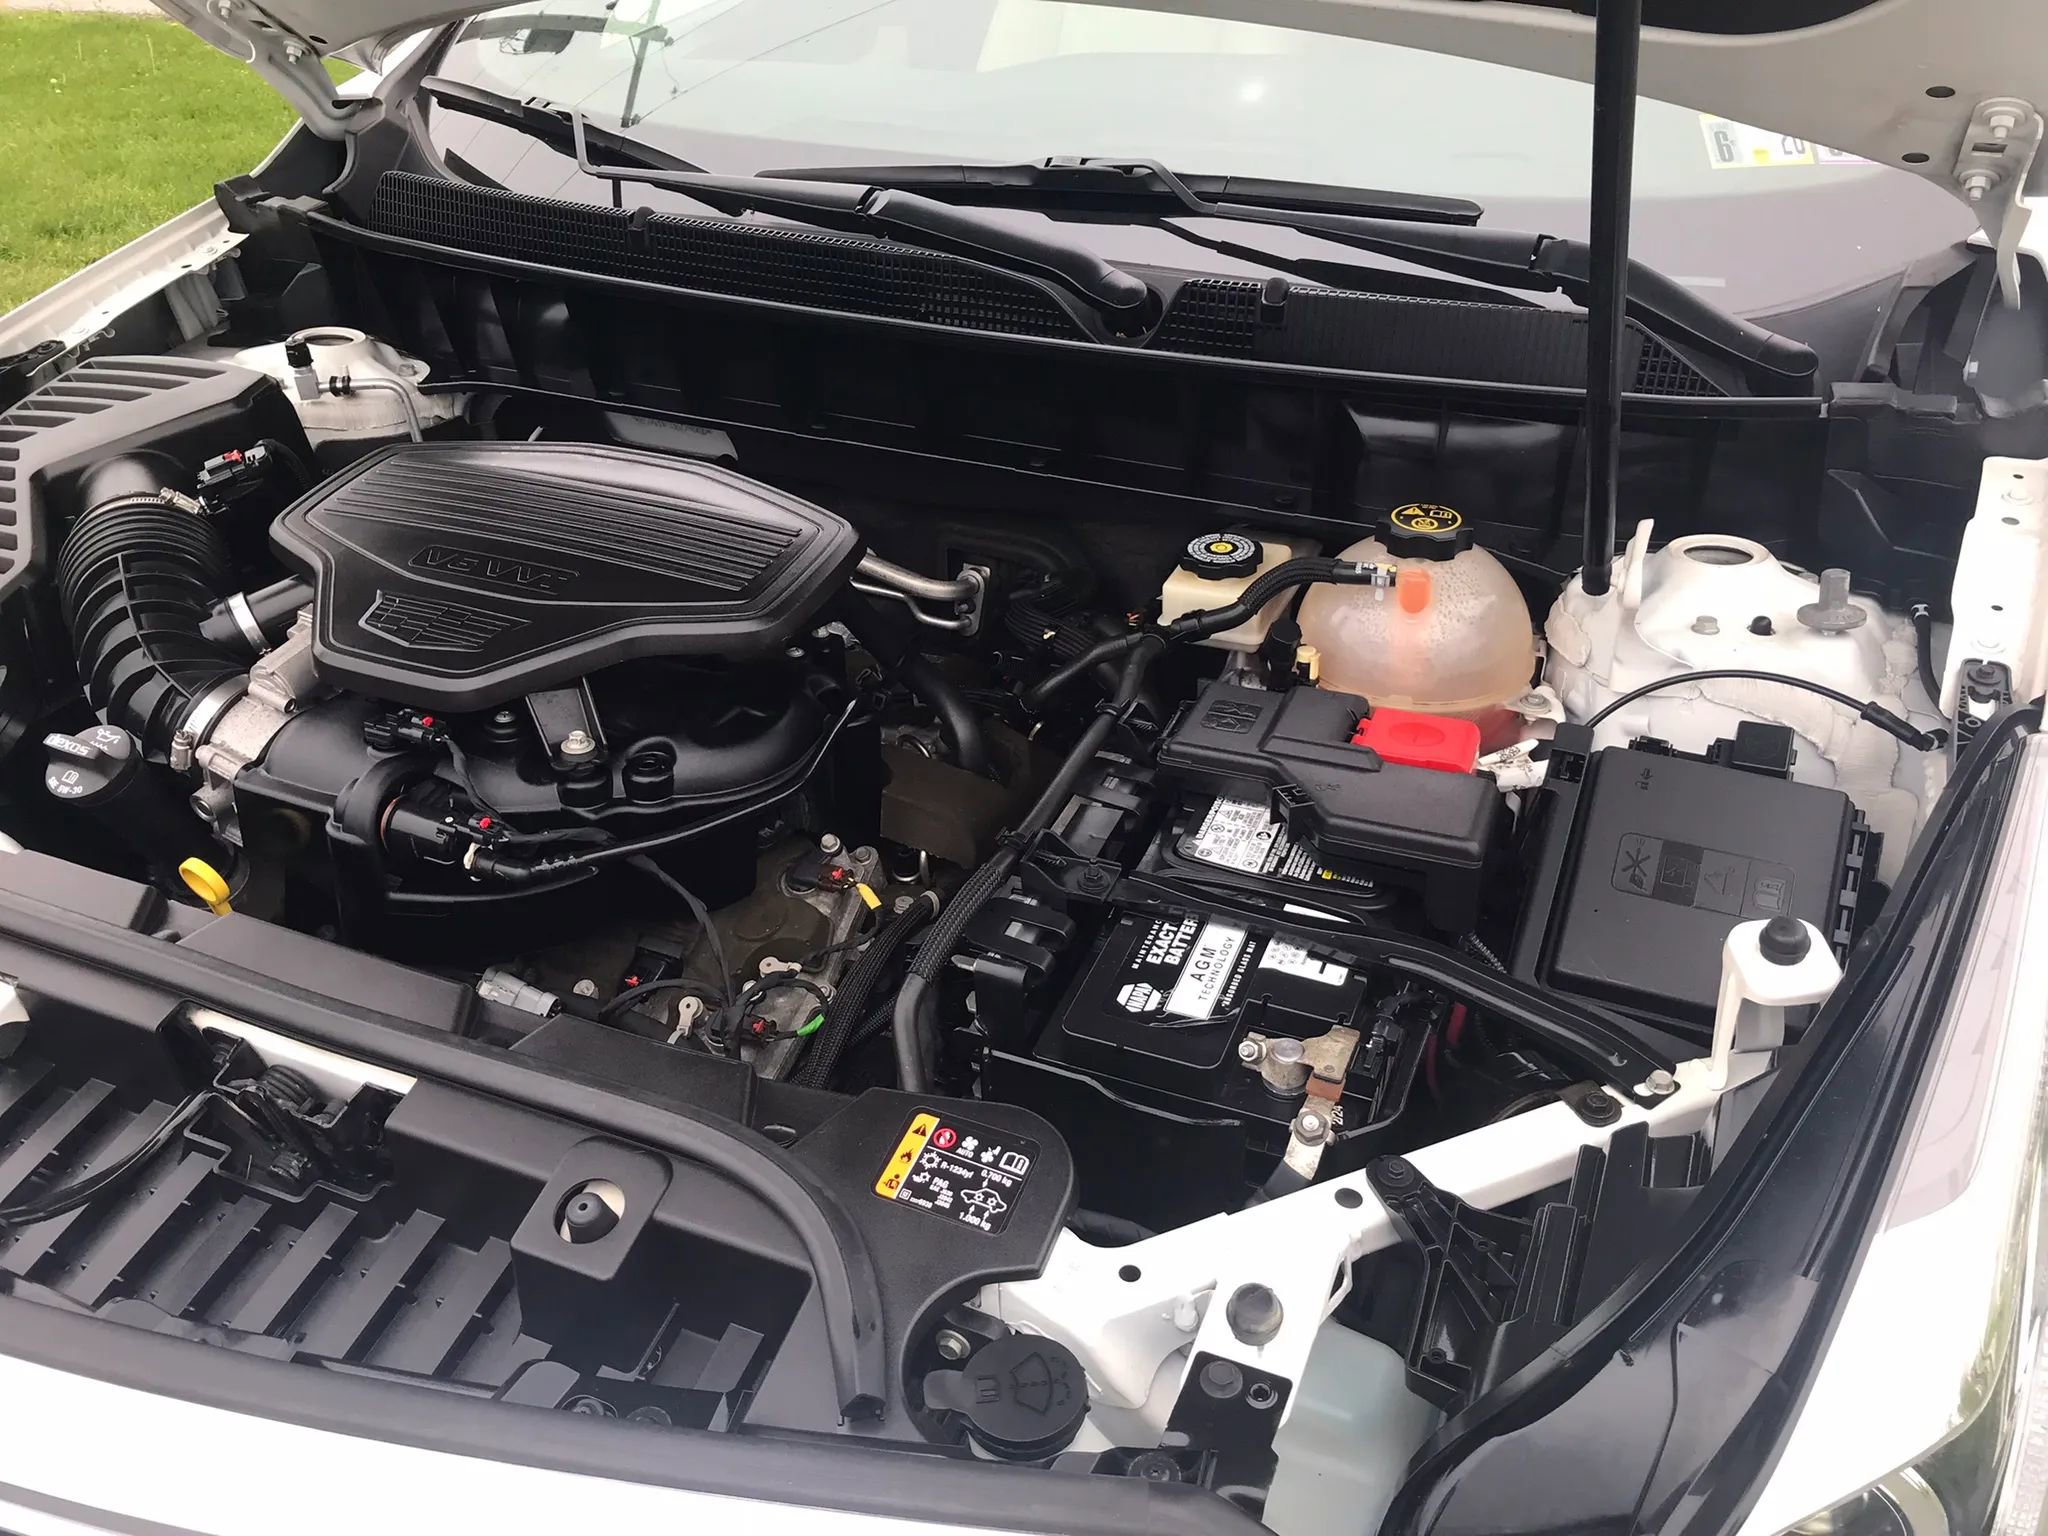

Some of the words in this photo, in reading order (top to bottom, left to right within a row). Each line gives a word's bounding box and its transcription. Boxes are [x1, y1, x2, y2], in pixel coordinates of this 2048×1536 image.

[47, 734, 90, 756] dexos
[57, 786, 83, 795] 5W-30
[1146, 922, 1178, 965] EXACT
[1190, 945, 1217, 982] AGM
[1198, 936, 1236, 1001] TECHNOLOGY
[1237, 953, 1251, 973] GLASS
[956, 1147, 974, 1159] AUTO
[939, 1161, 974, 1179] R-1234yf
[932, 1176, 950, 1189] PAG
[1001, 1177, 1013, 1188] kg
[958, 1212, 981, 1226] 1.000
[980, 1220, 992, 1231] kg
